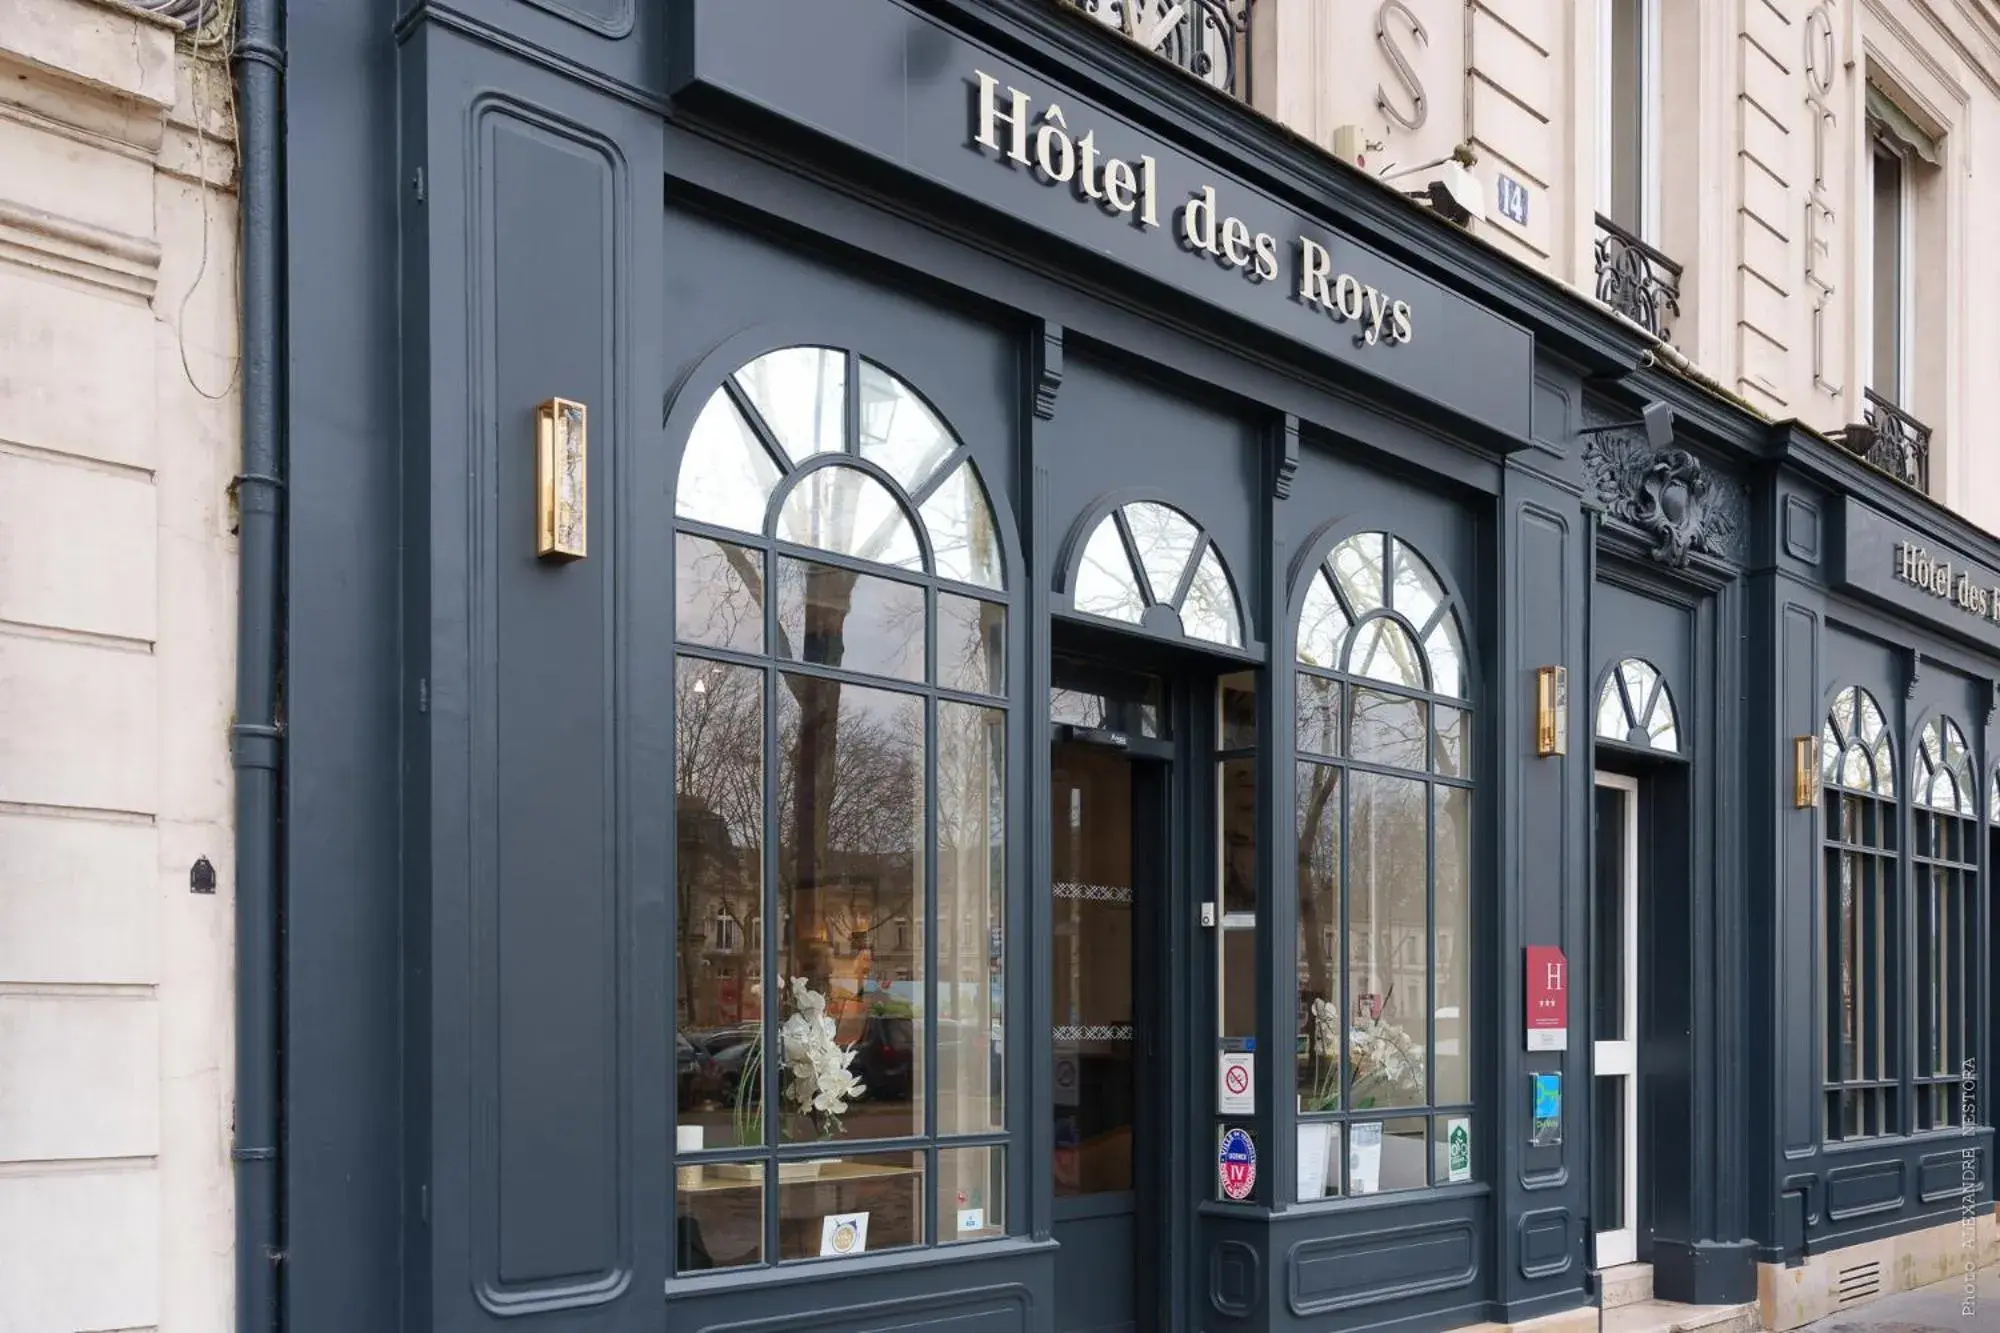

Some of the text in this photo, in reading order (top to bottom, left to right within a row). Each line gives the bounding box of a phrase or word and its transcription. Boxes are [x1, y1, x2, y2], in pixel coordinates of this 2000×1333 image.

[974, 69, 1412, 346] Hôtel des Roys
[1503, 178, 1523, 222] 14
[1902, 540, 1952, 598] Hôtel
[1958, 571, 1987, 615] des
[1546, 962, 1563, 990] H
[1230, 1164, 1245, 1181] IV
